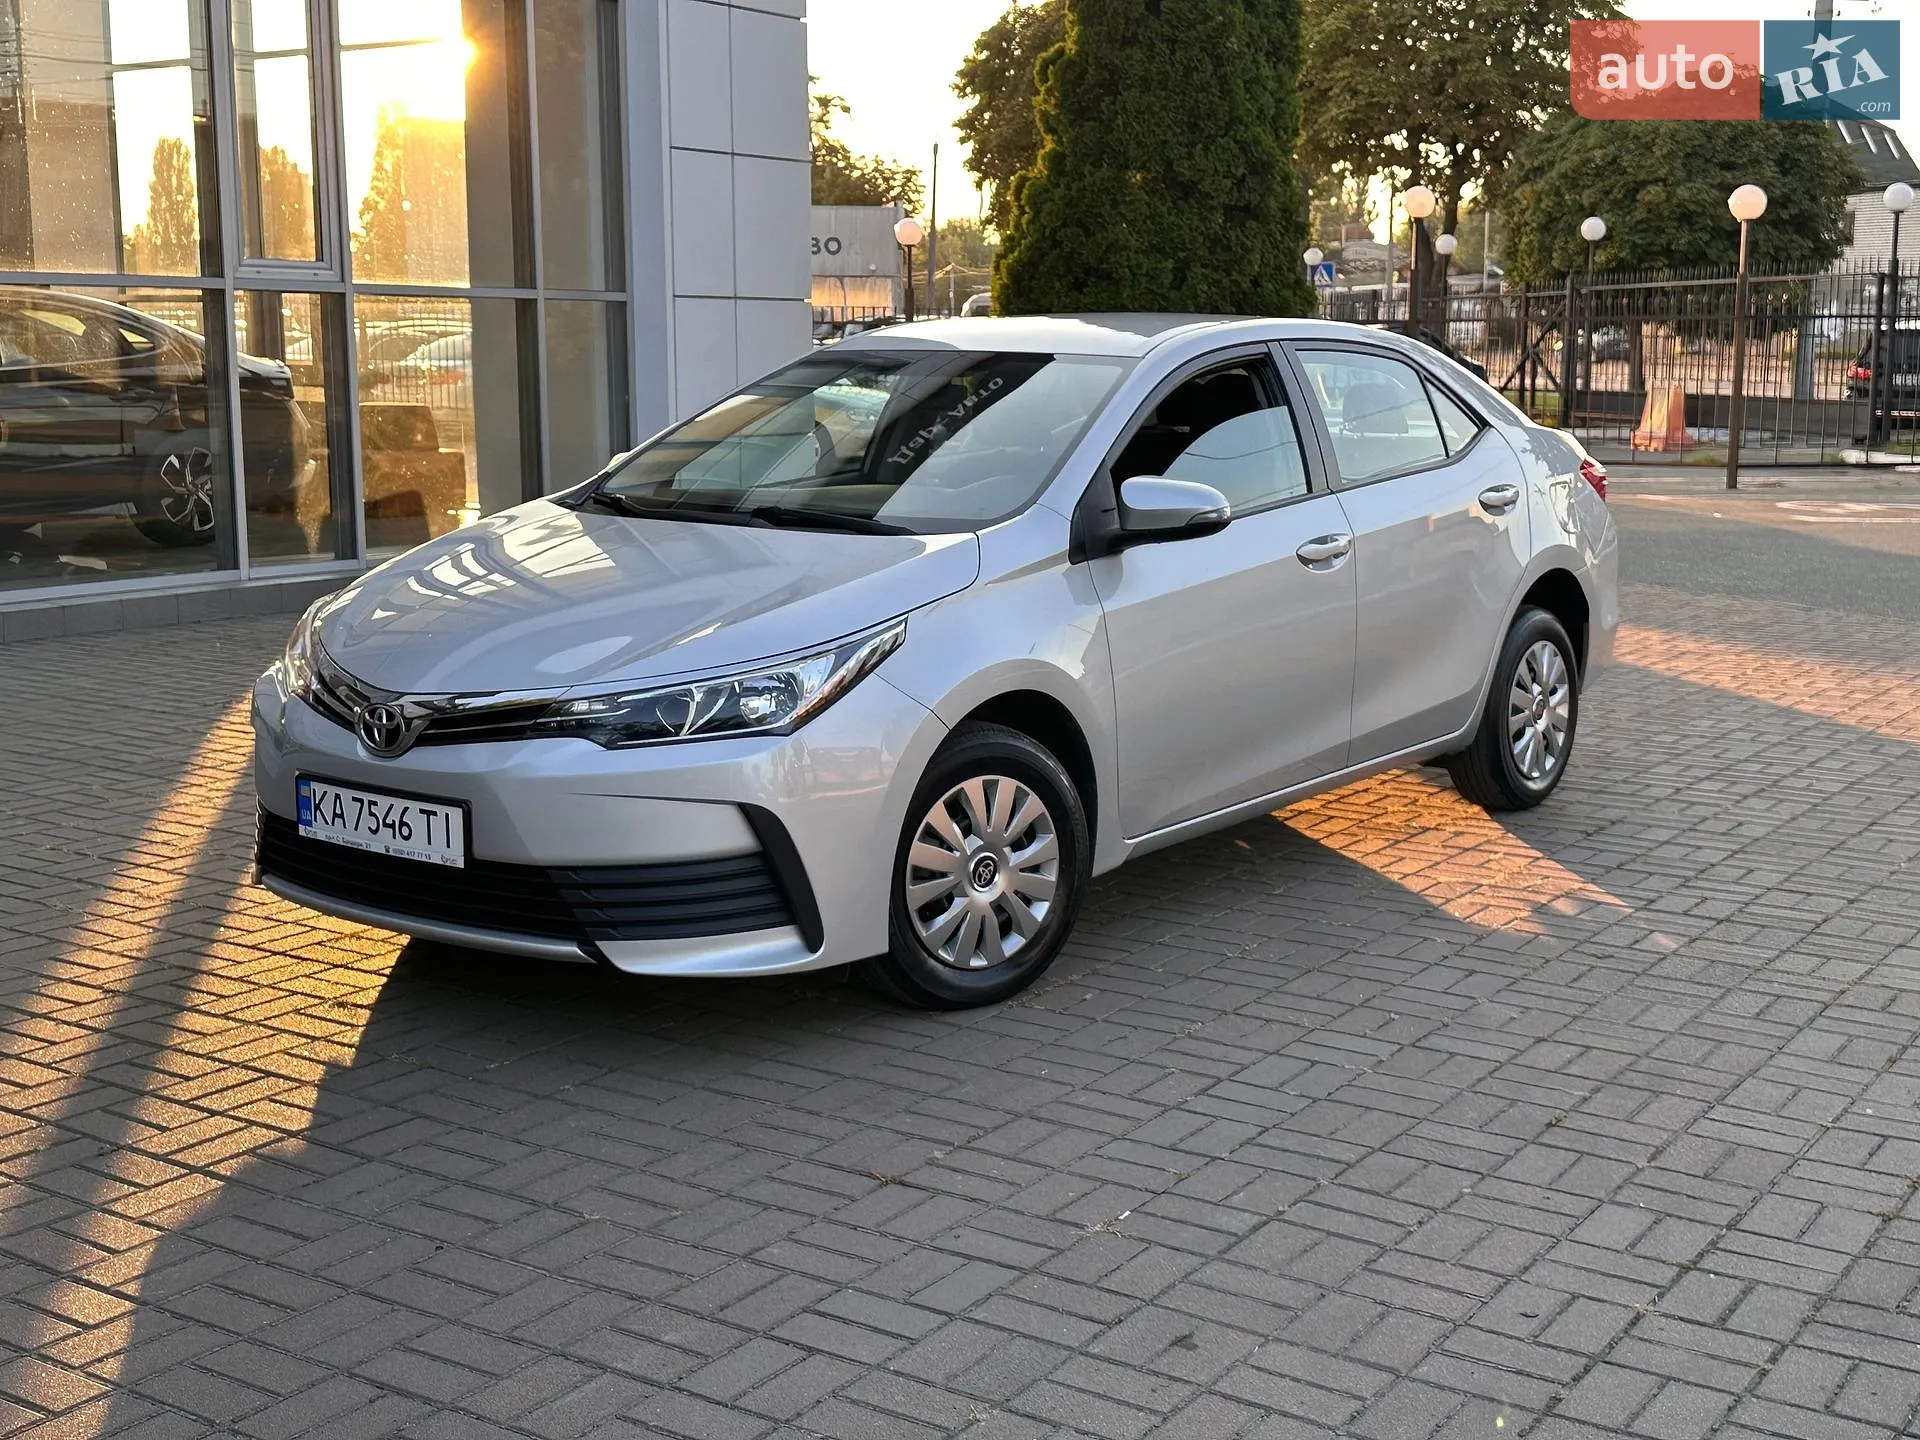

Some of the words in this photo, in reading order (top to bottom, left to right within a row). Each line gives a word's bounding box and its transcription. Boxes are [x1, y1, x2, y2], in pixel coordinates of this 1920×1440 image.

[302, 809, 312, 820] UA
[313, 788, 347, 829] KA
[352, 796, 412, 841] 7546
[418, 807, 451, 849] TI
